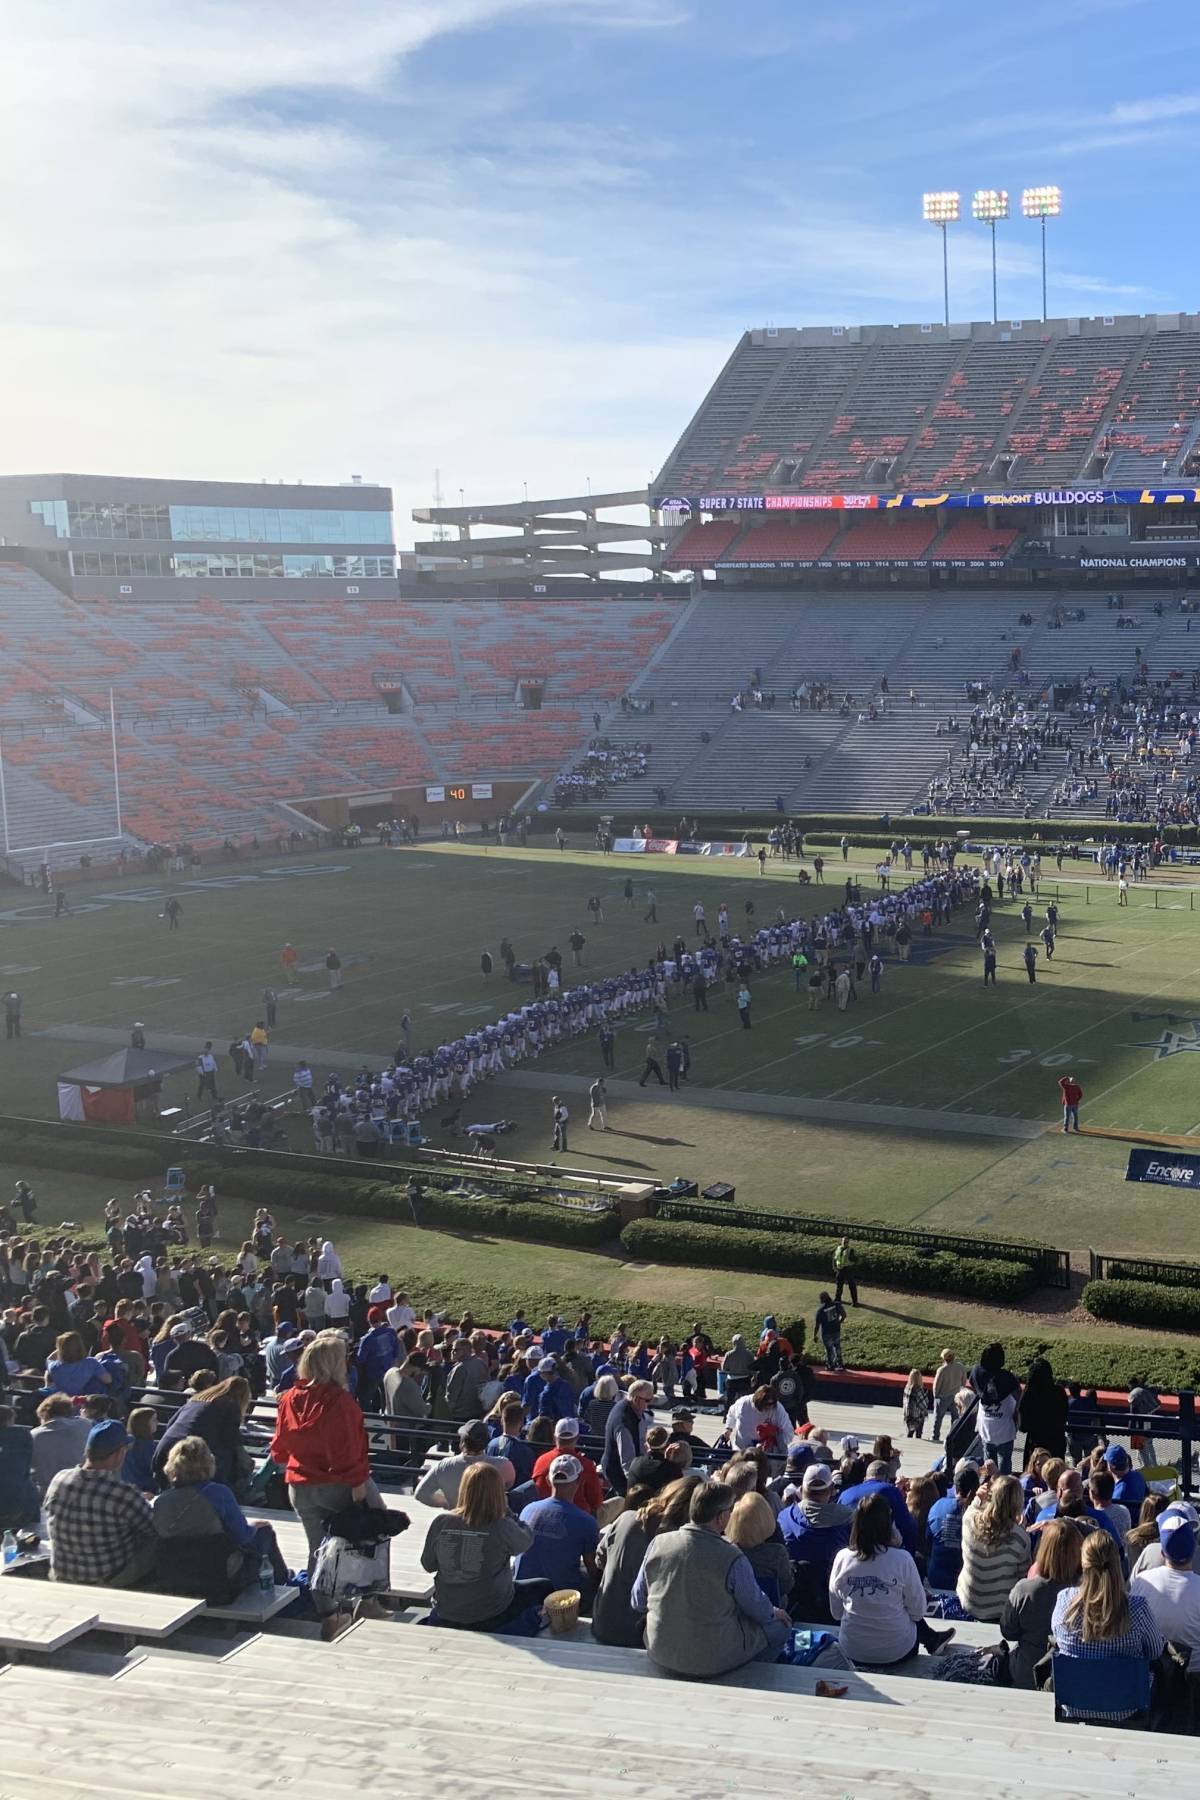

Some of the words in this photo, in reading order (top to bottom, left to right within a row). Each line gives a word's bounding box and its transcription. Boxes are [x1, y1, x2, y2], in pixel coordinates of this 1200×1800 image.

[700, 498, 727, 510] SUPER
[729, 498, 735, 510] 7
[737, 498, 763, 509] STATE
[765, 497, 833, 509] CHAMPIONSHIPS
[983, 495, 1033, 504] PIEDMONT
[1034, 491, 1104, 505] BULLDOGS
[1080, 558, 1128, 567] NATIONAL
[1129, 557, 1187, 567] CHAMPIONS
[450, 788, 465, 800] 40
[997, 1049, 1075, 1067] 30
[1146, 1161, 1194, 1180] Encore
